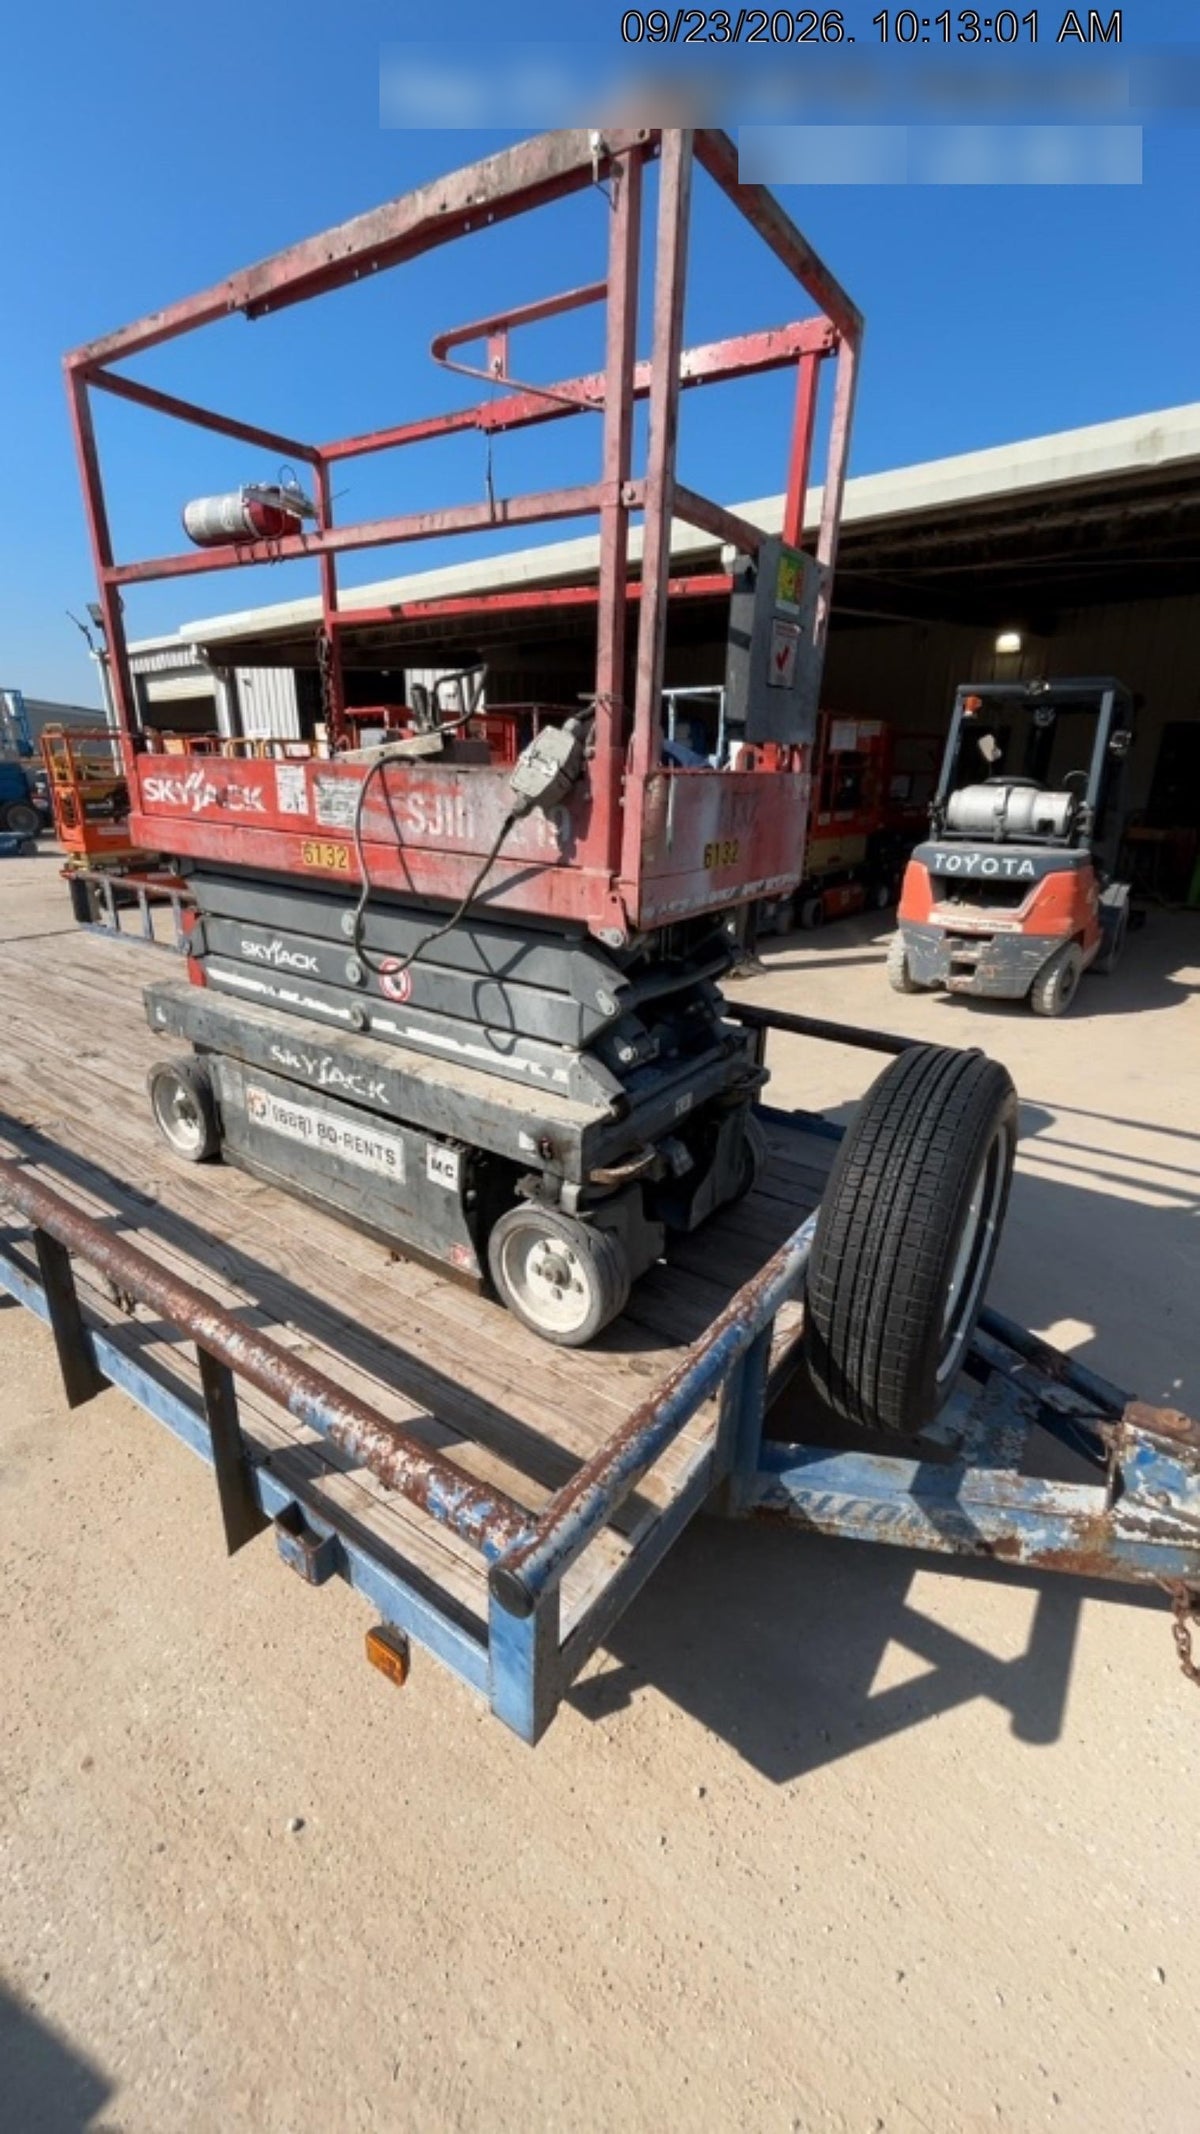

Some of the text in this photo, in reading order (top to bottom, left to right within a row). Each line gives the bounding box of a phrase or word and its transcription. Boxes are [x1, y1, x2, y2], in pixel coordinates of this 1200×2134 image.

[303, 842, 348, 869] 6132
[703, 838, 739, 869] 6132
[934, 853, 1035, 876] TOYOTA
[240, 939, 320, 973] SKYJACK
